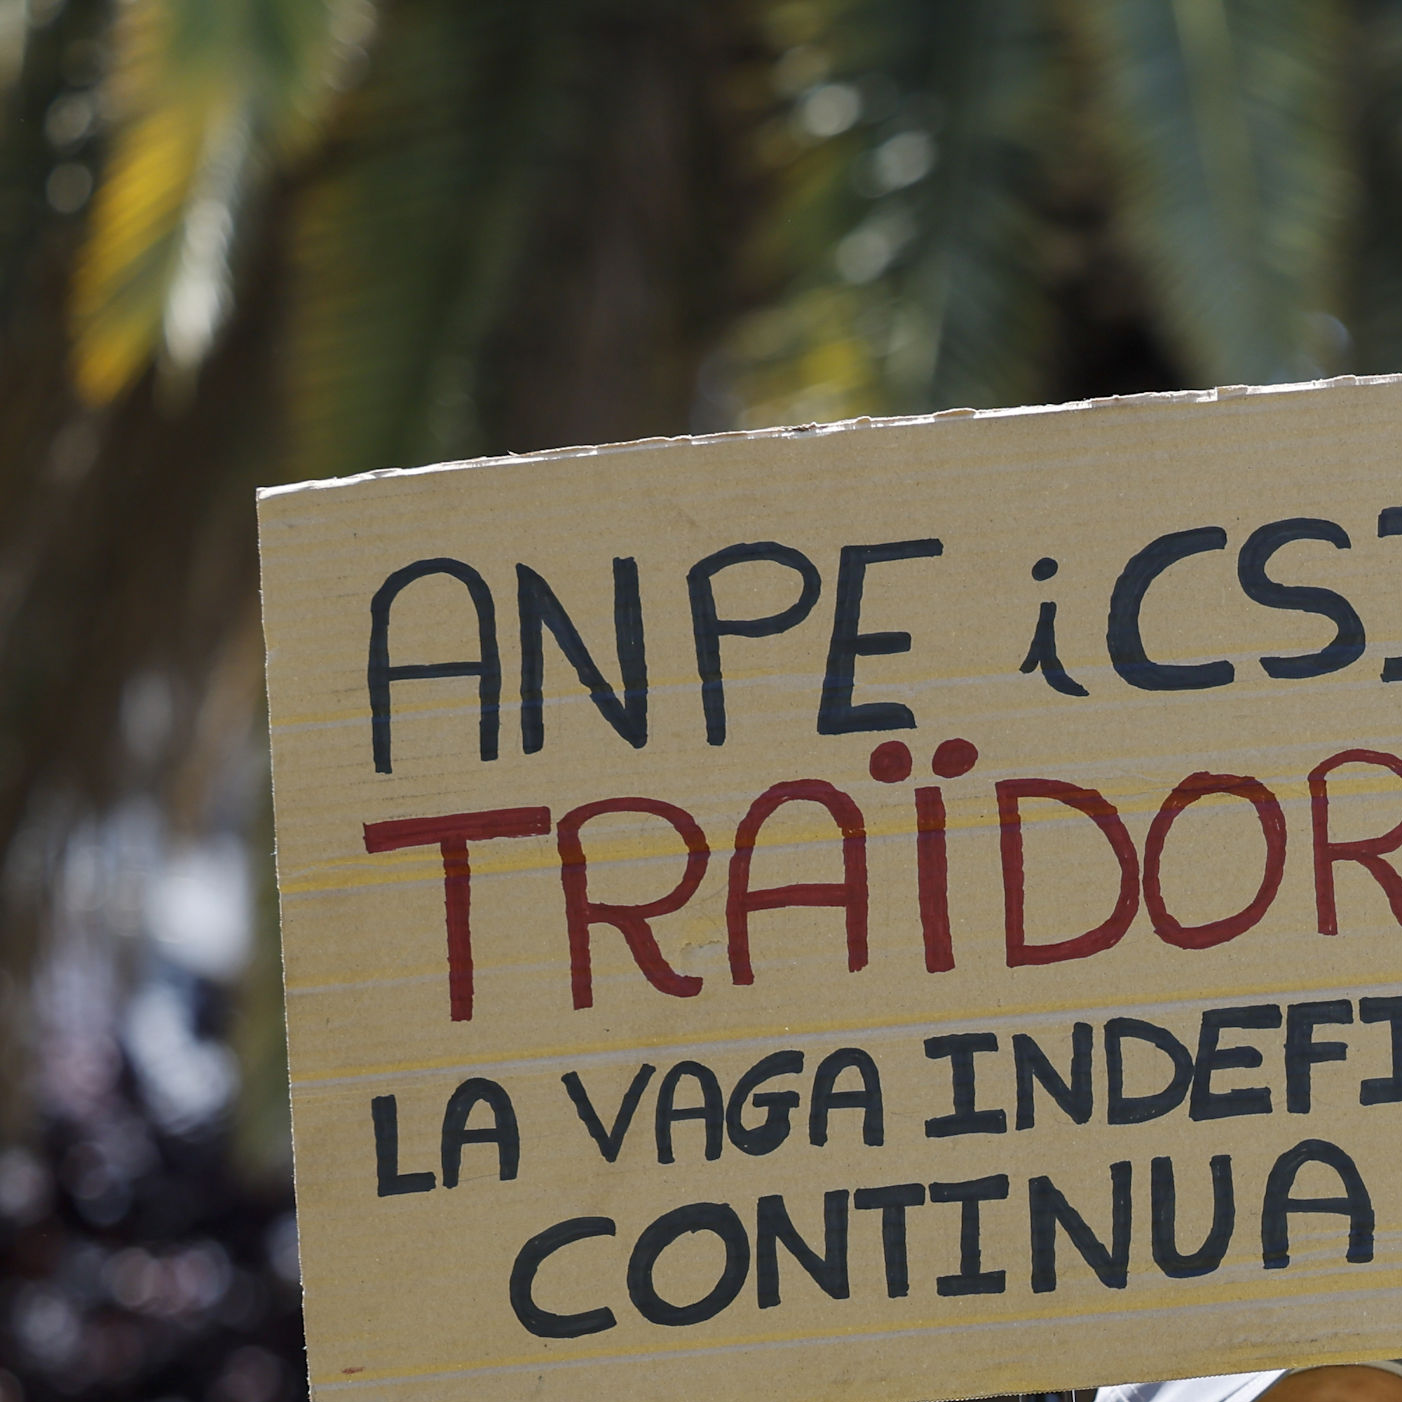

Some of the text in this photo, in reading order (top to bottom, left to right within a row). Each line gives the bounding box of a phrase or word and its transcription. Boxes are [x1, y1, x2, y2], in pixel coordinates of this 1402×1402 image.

[366, 537, 944, 775] ANPE
[370, 1076, 520, 1198] LA
[560, 1046, 885, 1166] VAGA
[509, 1137, 1376, 1339] CONTINUA
